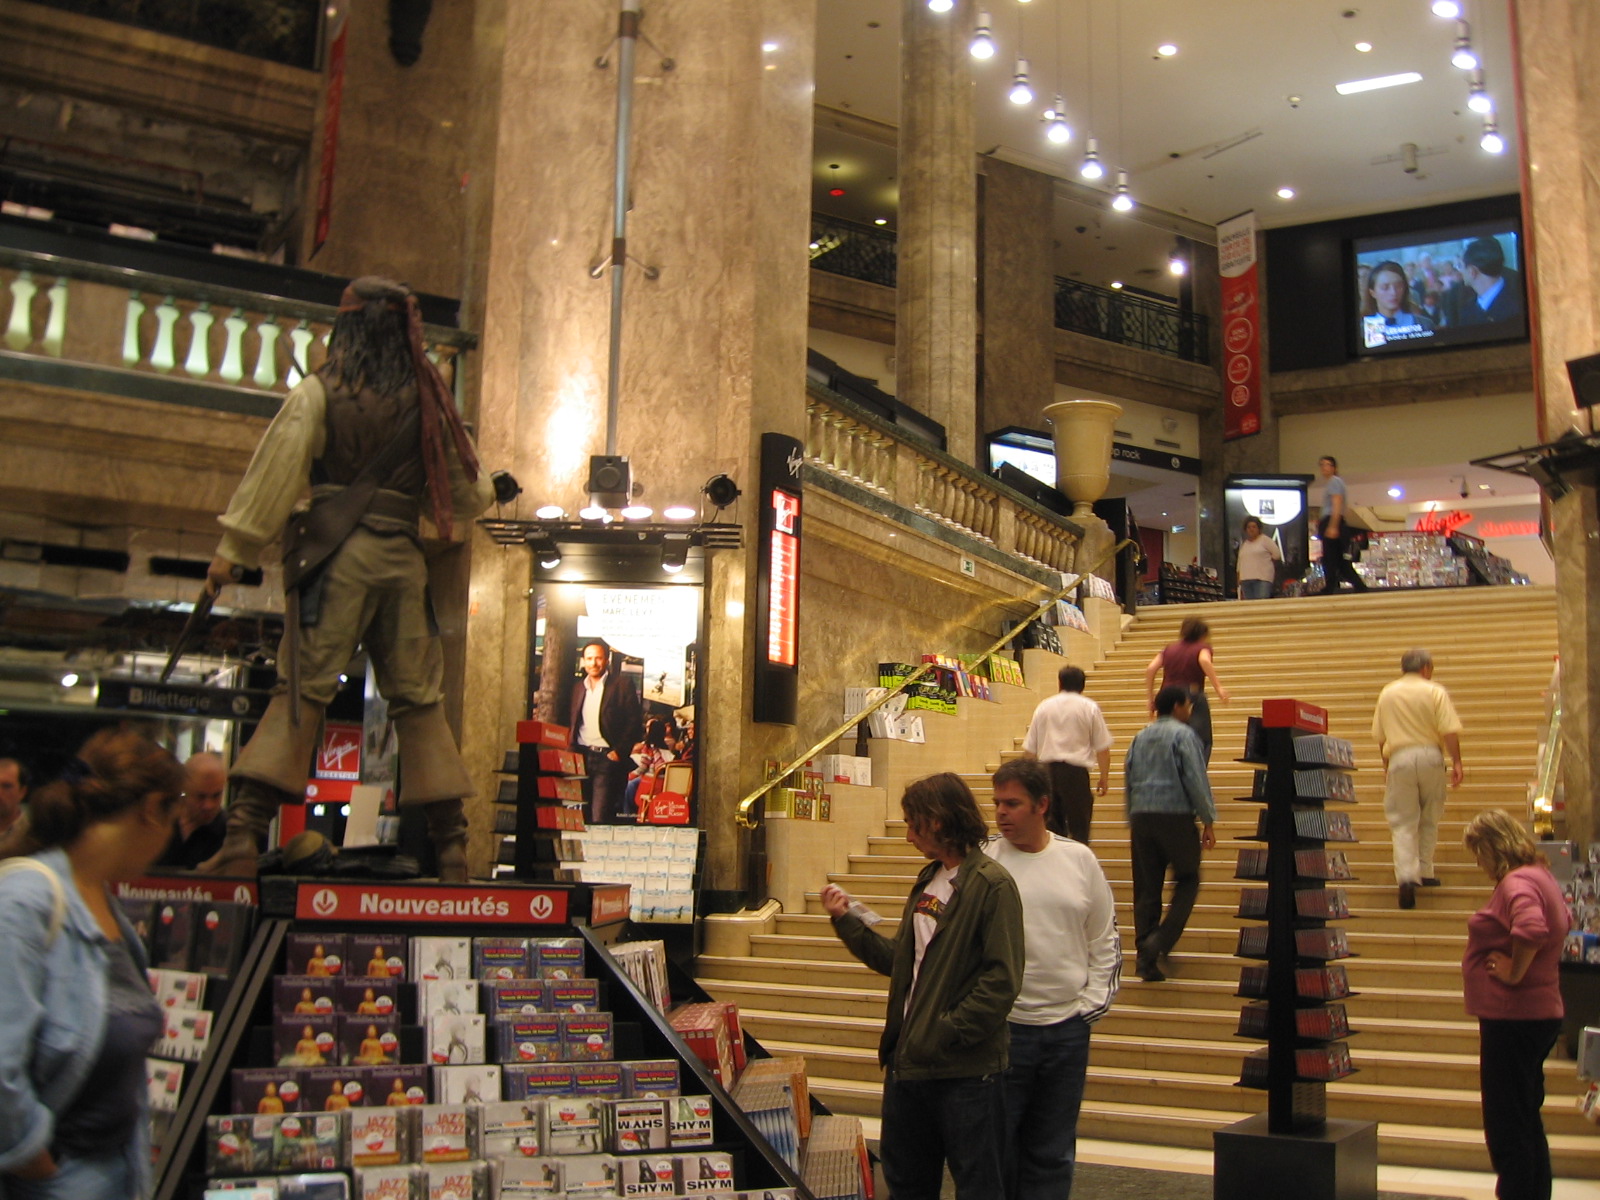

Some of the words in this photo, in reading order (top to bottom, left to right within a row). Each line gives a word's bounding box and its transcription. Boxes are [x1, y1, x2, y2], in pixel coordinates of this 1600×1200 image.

[1122, 449, 1141, 459] rock
[129, 687, 210, 710] Billetterie
[323, 732, 358, 770] Virgin
[118, 881, 213, 901] Nouveautés
[360, 892, 509, 916] Nouveautés
[366, 1116, 395, 1128] JAZZ
[436, 1113, 465, 1125] JAZZ
[618, 1120, 664, 1130] SHY'M
[669, 1120, 711, 1131] SHY'M
[379, 1178, 408, 1191] JAZZ
[443, 1175, 471, 1189] JAZZ
[686, 1179, 732, 1191] SHY'M
[626, 1183, 673, 1194] SHY'M
